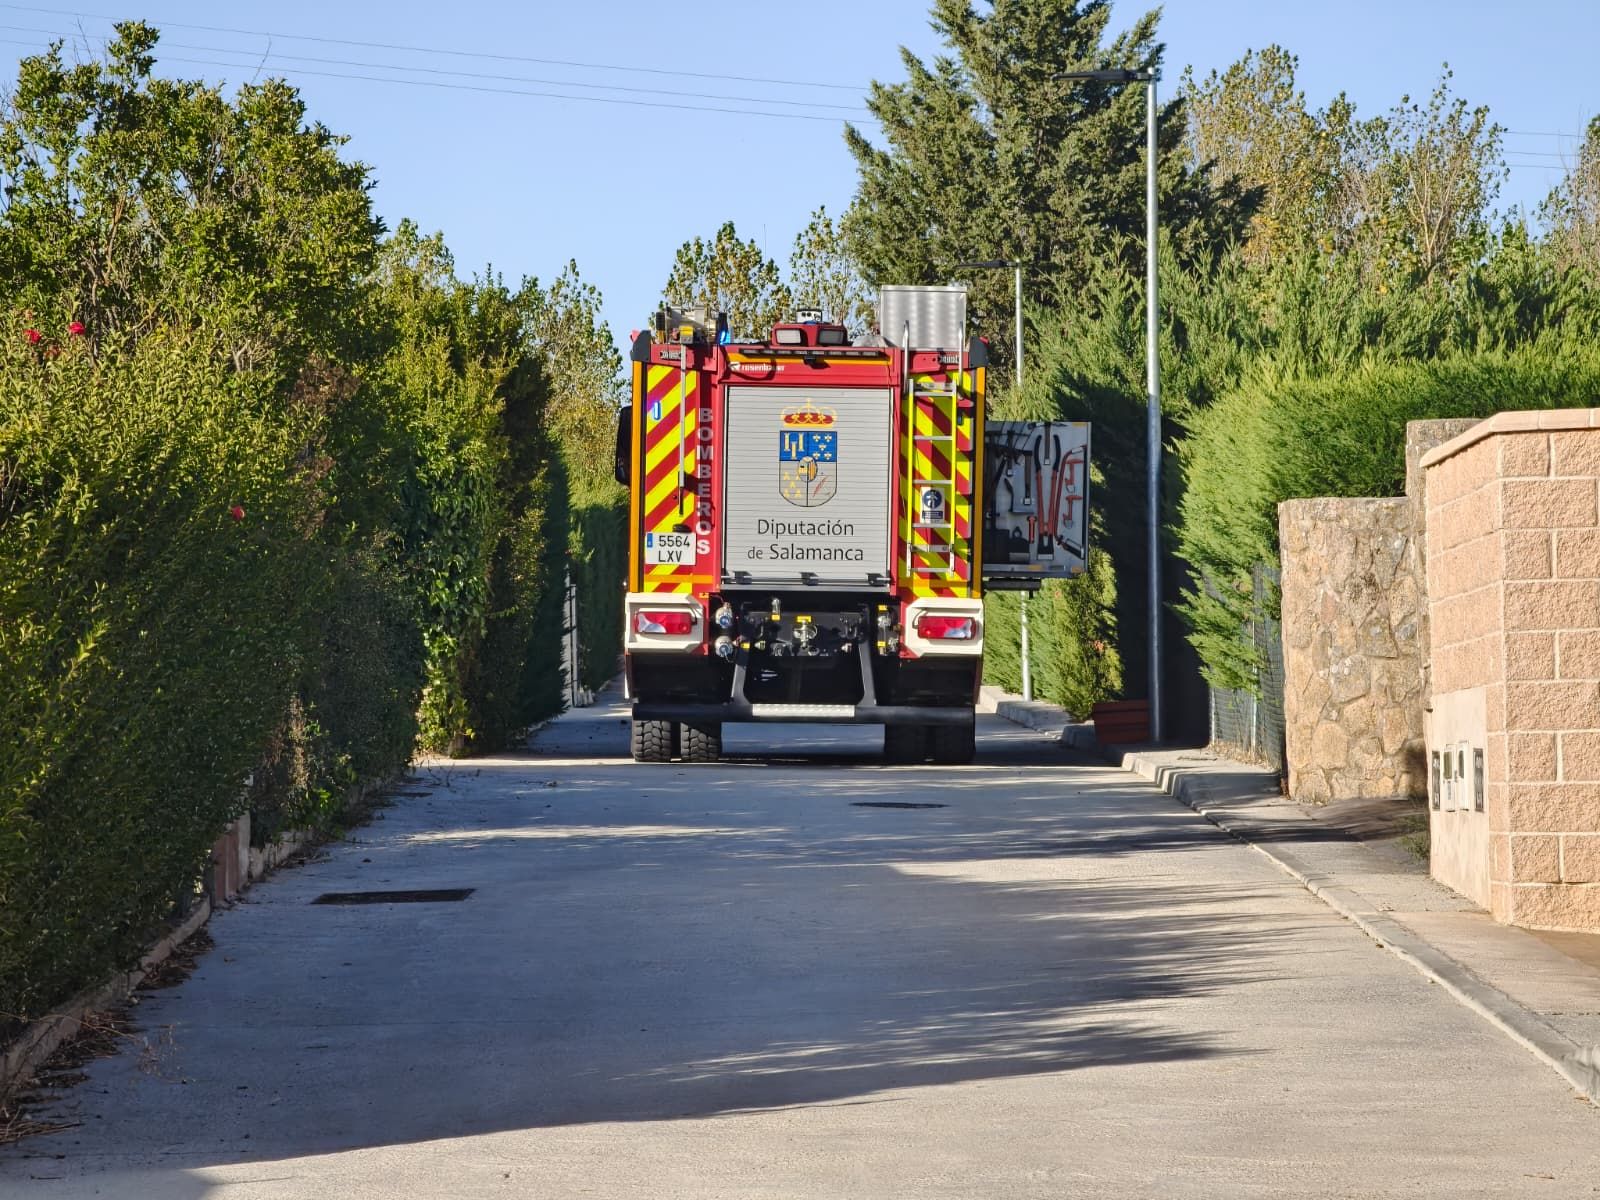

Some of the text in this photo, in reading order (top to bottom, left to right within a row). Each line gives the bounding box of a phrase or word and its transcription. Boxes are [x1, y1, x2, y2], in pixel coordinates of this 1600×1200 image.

[695, 407, 714, 555] BOMBEROS
[757, 518, 854, 539] Diputación
[658, 535, 691, 548] 5564
[658, 550, 683, 563] LXV
[747, 543, 864, 561] de Salamanca
